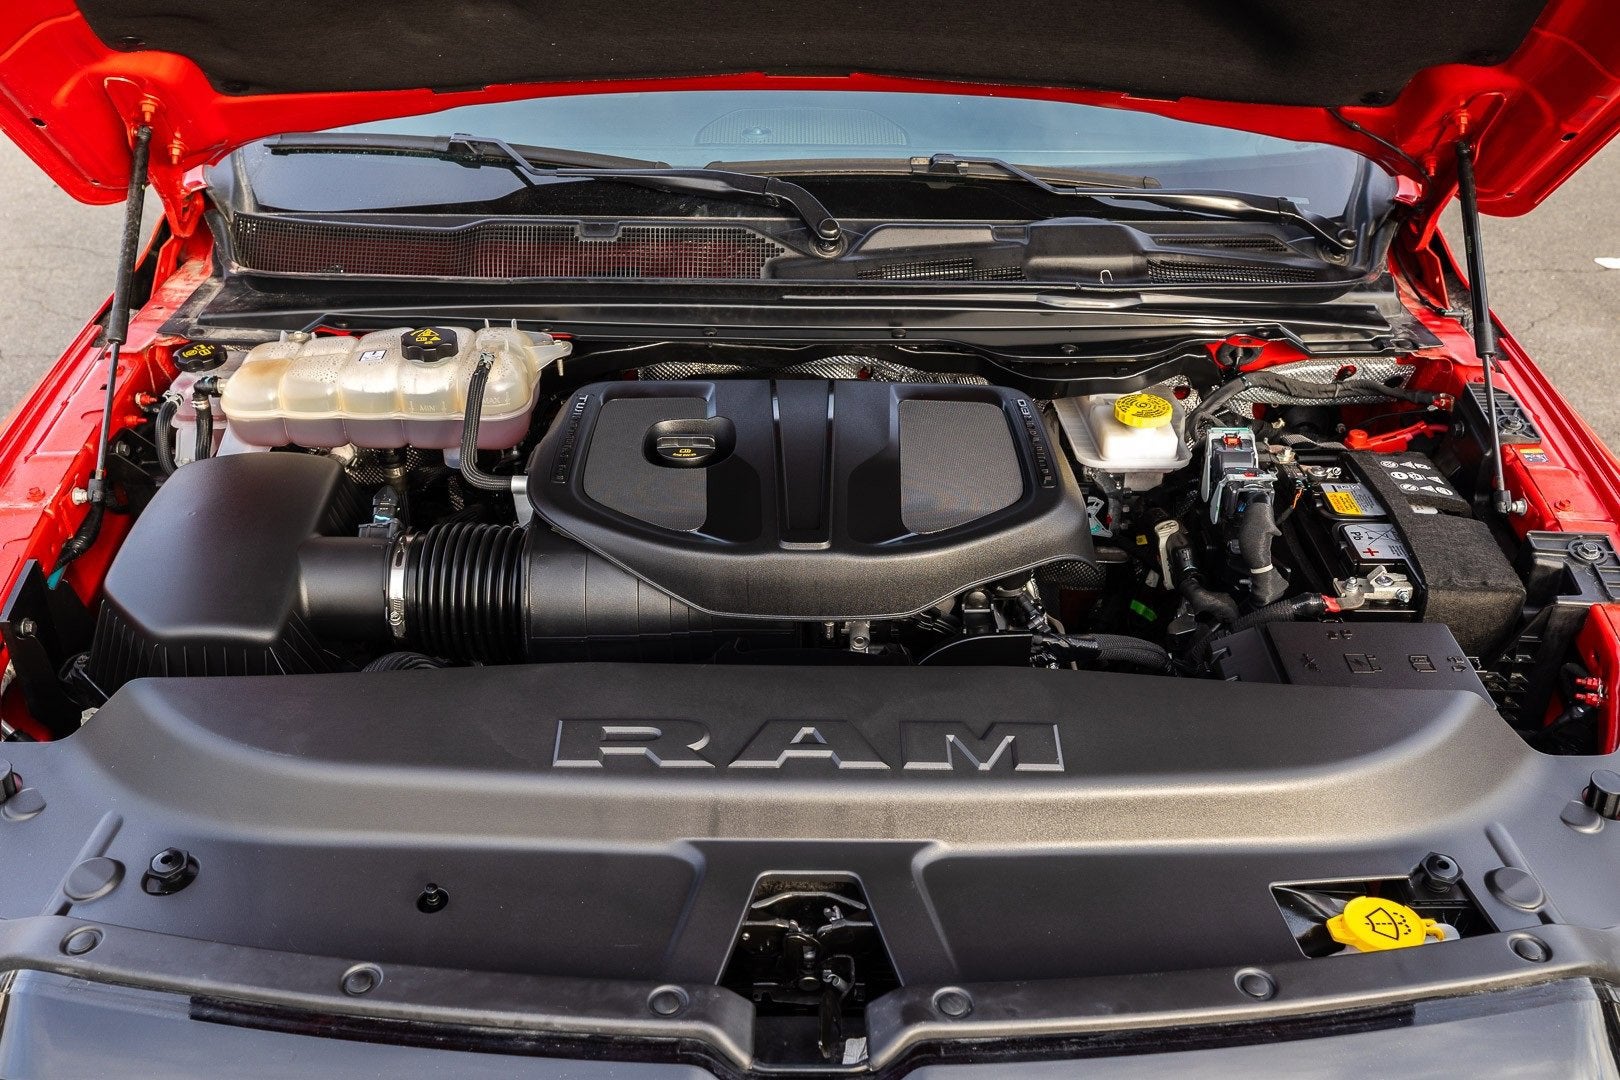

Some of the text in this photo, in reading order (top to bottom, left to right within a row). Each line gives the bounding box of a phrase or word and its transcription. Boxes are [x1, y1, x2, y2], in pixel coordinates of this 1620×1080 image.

[419, 404, 436, 412] MIN
[1350, 531, 1364, 541] Pb
[552, 719, 1065, 772] RAM
